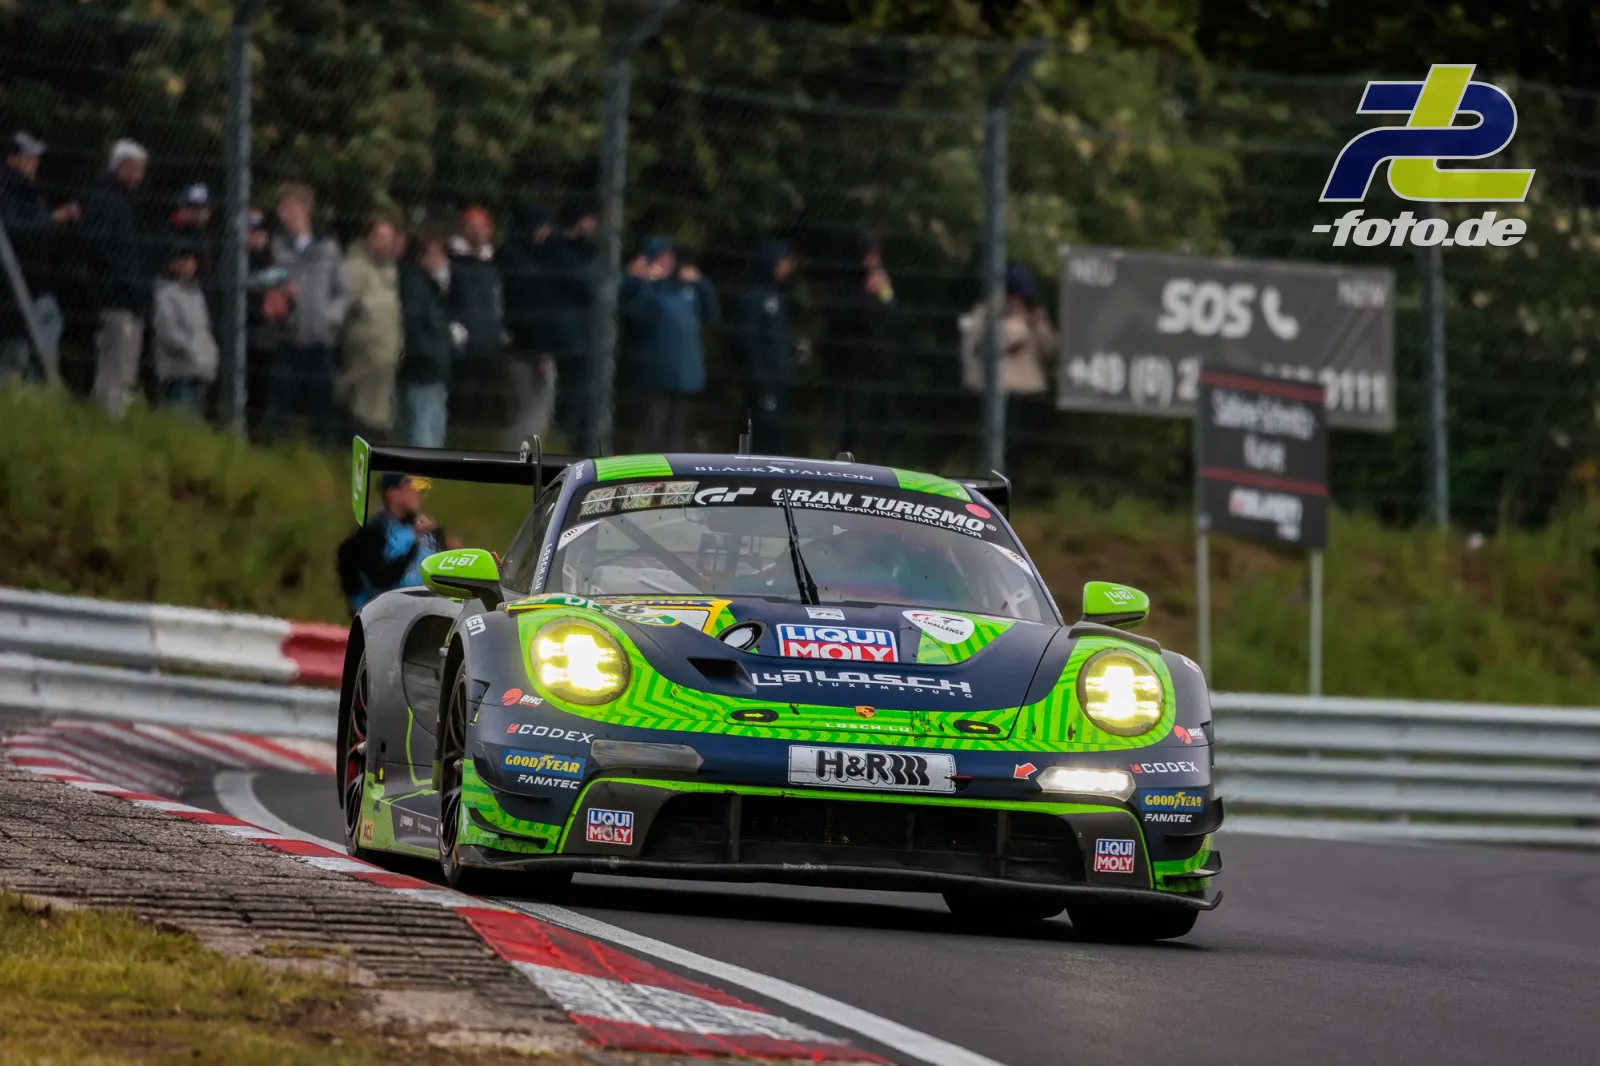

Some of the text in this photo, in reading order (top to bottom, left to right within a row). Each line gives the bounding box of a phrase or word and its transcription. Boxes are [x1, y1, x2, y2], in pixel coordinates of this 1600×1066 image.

[1157, 278, 1257, 338] SOS
[695, 487, 756, 504] GT
[771, 488, 852, 505] GRAN
[805, 502, 842, 510] REAL
[844, 506, 902, 518] DRIVING
[903, 515, 983, 538] SIMULATOR
[786, 626, 888, 645] LIQUI
[923, 621, 965, 635] CHALLENGE
[783, 643, 893, 662] MOLY
[815, 671, 972, 693] LOSCH
[817, 682, 973, 698] LUXEMBOURG
[518, 724, 594, 743] CODEX
[505, 754, 580, 773] GOODYEAR
[816, 750, 892, 785] H&R
[1141, 761, 1200, 773] CODEX
[517, 774, 580, 789] FANATEC
[590, 811, 631, 827] LIQUI
[1144, 813, 1192, 822] FANATEC
[589, 825, 632, 842] MOLY
[1098, 842, 1132, 855] LIQUI
[1097, 856, 1133, 871] MOLY
